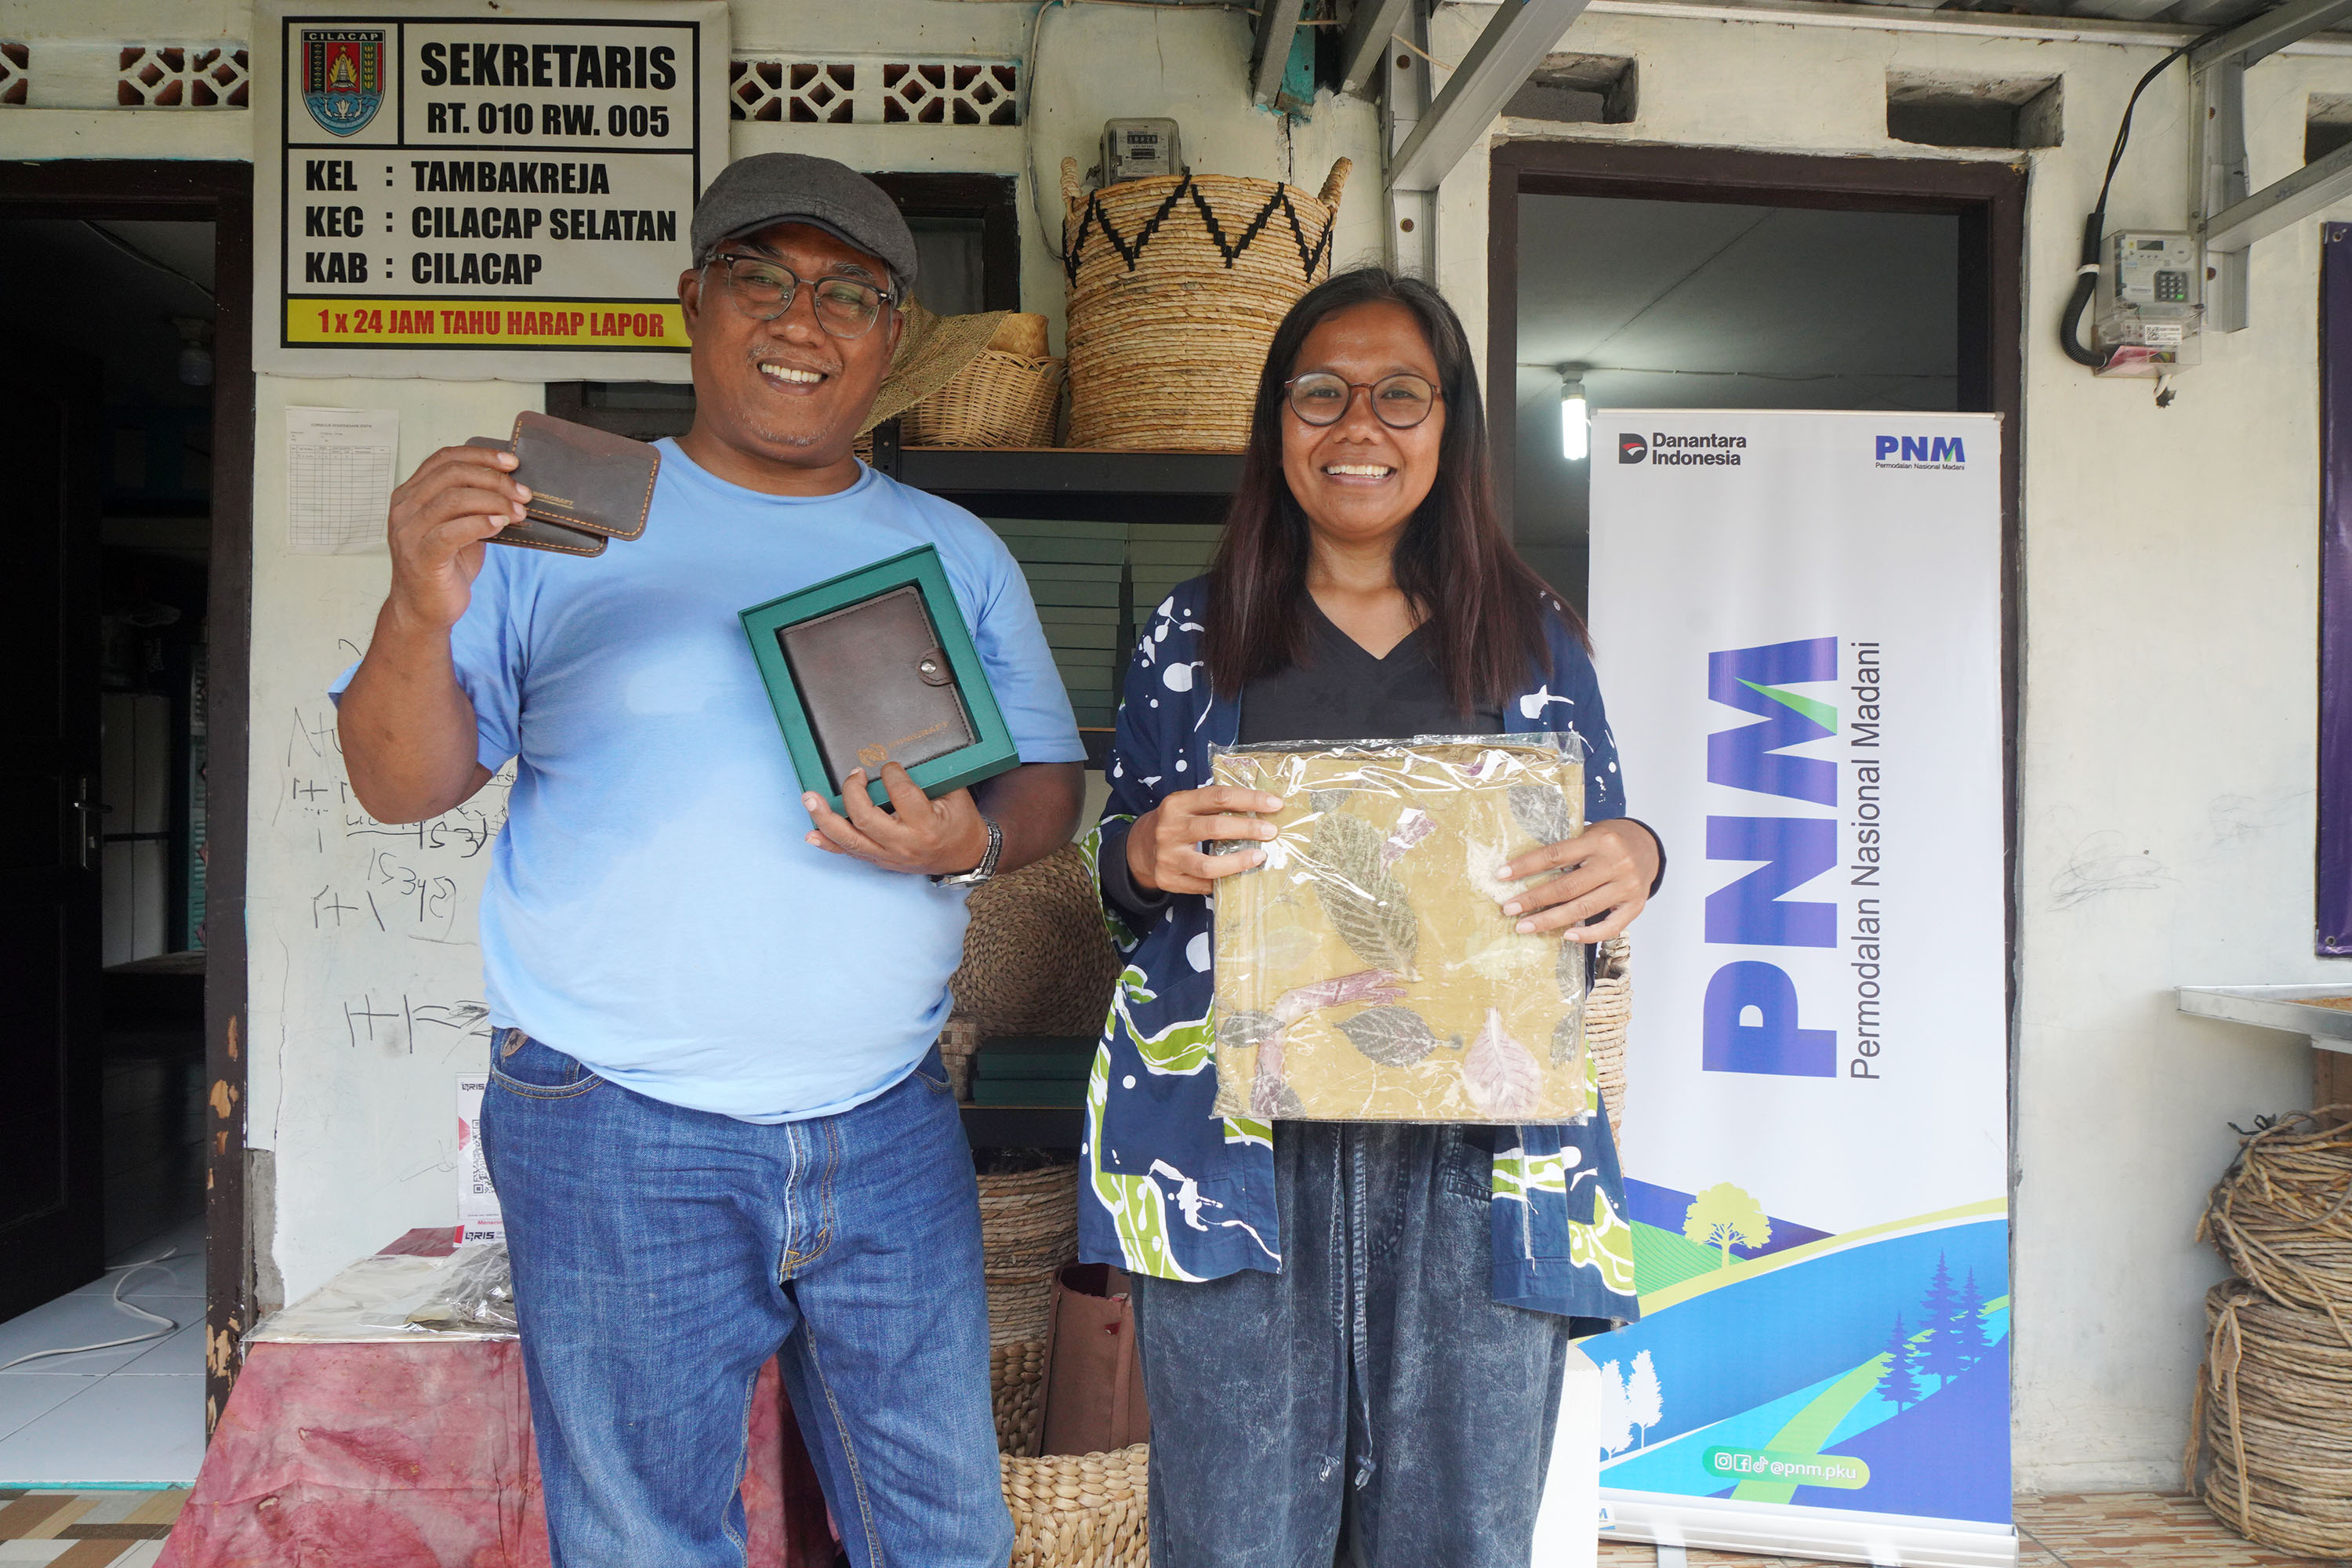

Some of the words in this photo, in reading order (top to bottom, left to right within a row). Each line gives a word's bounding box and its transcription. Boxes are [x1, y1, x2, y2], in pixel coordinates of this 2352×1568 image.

[421, 42, 676, 90] SEKRETARIS
[428, 103, 469, 133] RT.
[478, 103, 532, 134] 010
[543, 104, 600, 136] RW.
[608, 105, 669, 137] 005
[307, 161, 357, 191] KEL
[412, 162, 609, 194] TAMBAKREJA
[307, 206, 363, 238] KEC
[412, 207, 541, 238] CILACAP
[550, 209, 676, 241] SELATAN
[306, 252, 367, 283] KAB
[412, 252, 541, 285] CILACAP
[318, 309, 328, 332] 1
[354, 310, 383, 333] 24
[389, 310, 434, 334] JAM
[440, 310, 500, 335] TAHU
[508, 311, 583, 336] HARAP
[590, 313, 663, 337] LAPOR
[1652, 432, 1747, 448] Danantara
[1875, 435, 1965, 463] PNM
[1652, 450, 1741, 466] Indonesia
[1850, 642, 1880, 747] Madani
[1850, 759, 1880, 887] Nasional
[1702, 636, 1838, 1078] PNM
[1850, 898, 1880, 1080] Permodalan
[465, 1232, 495, 1241] QRIS
[1770, 1461, 1857, 1480] @pnm.pku
